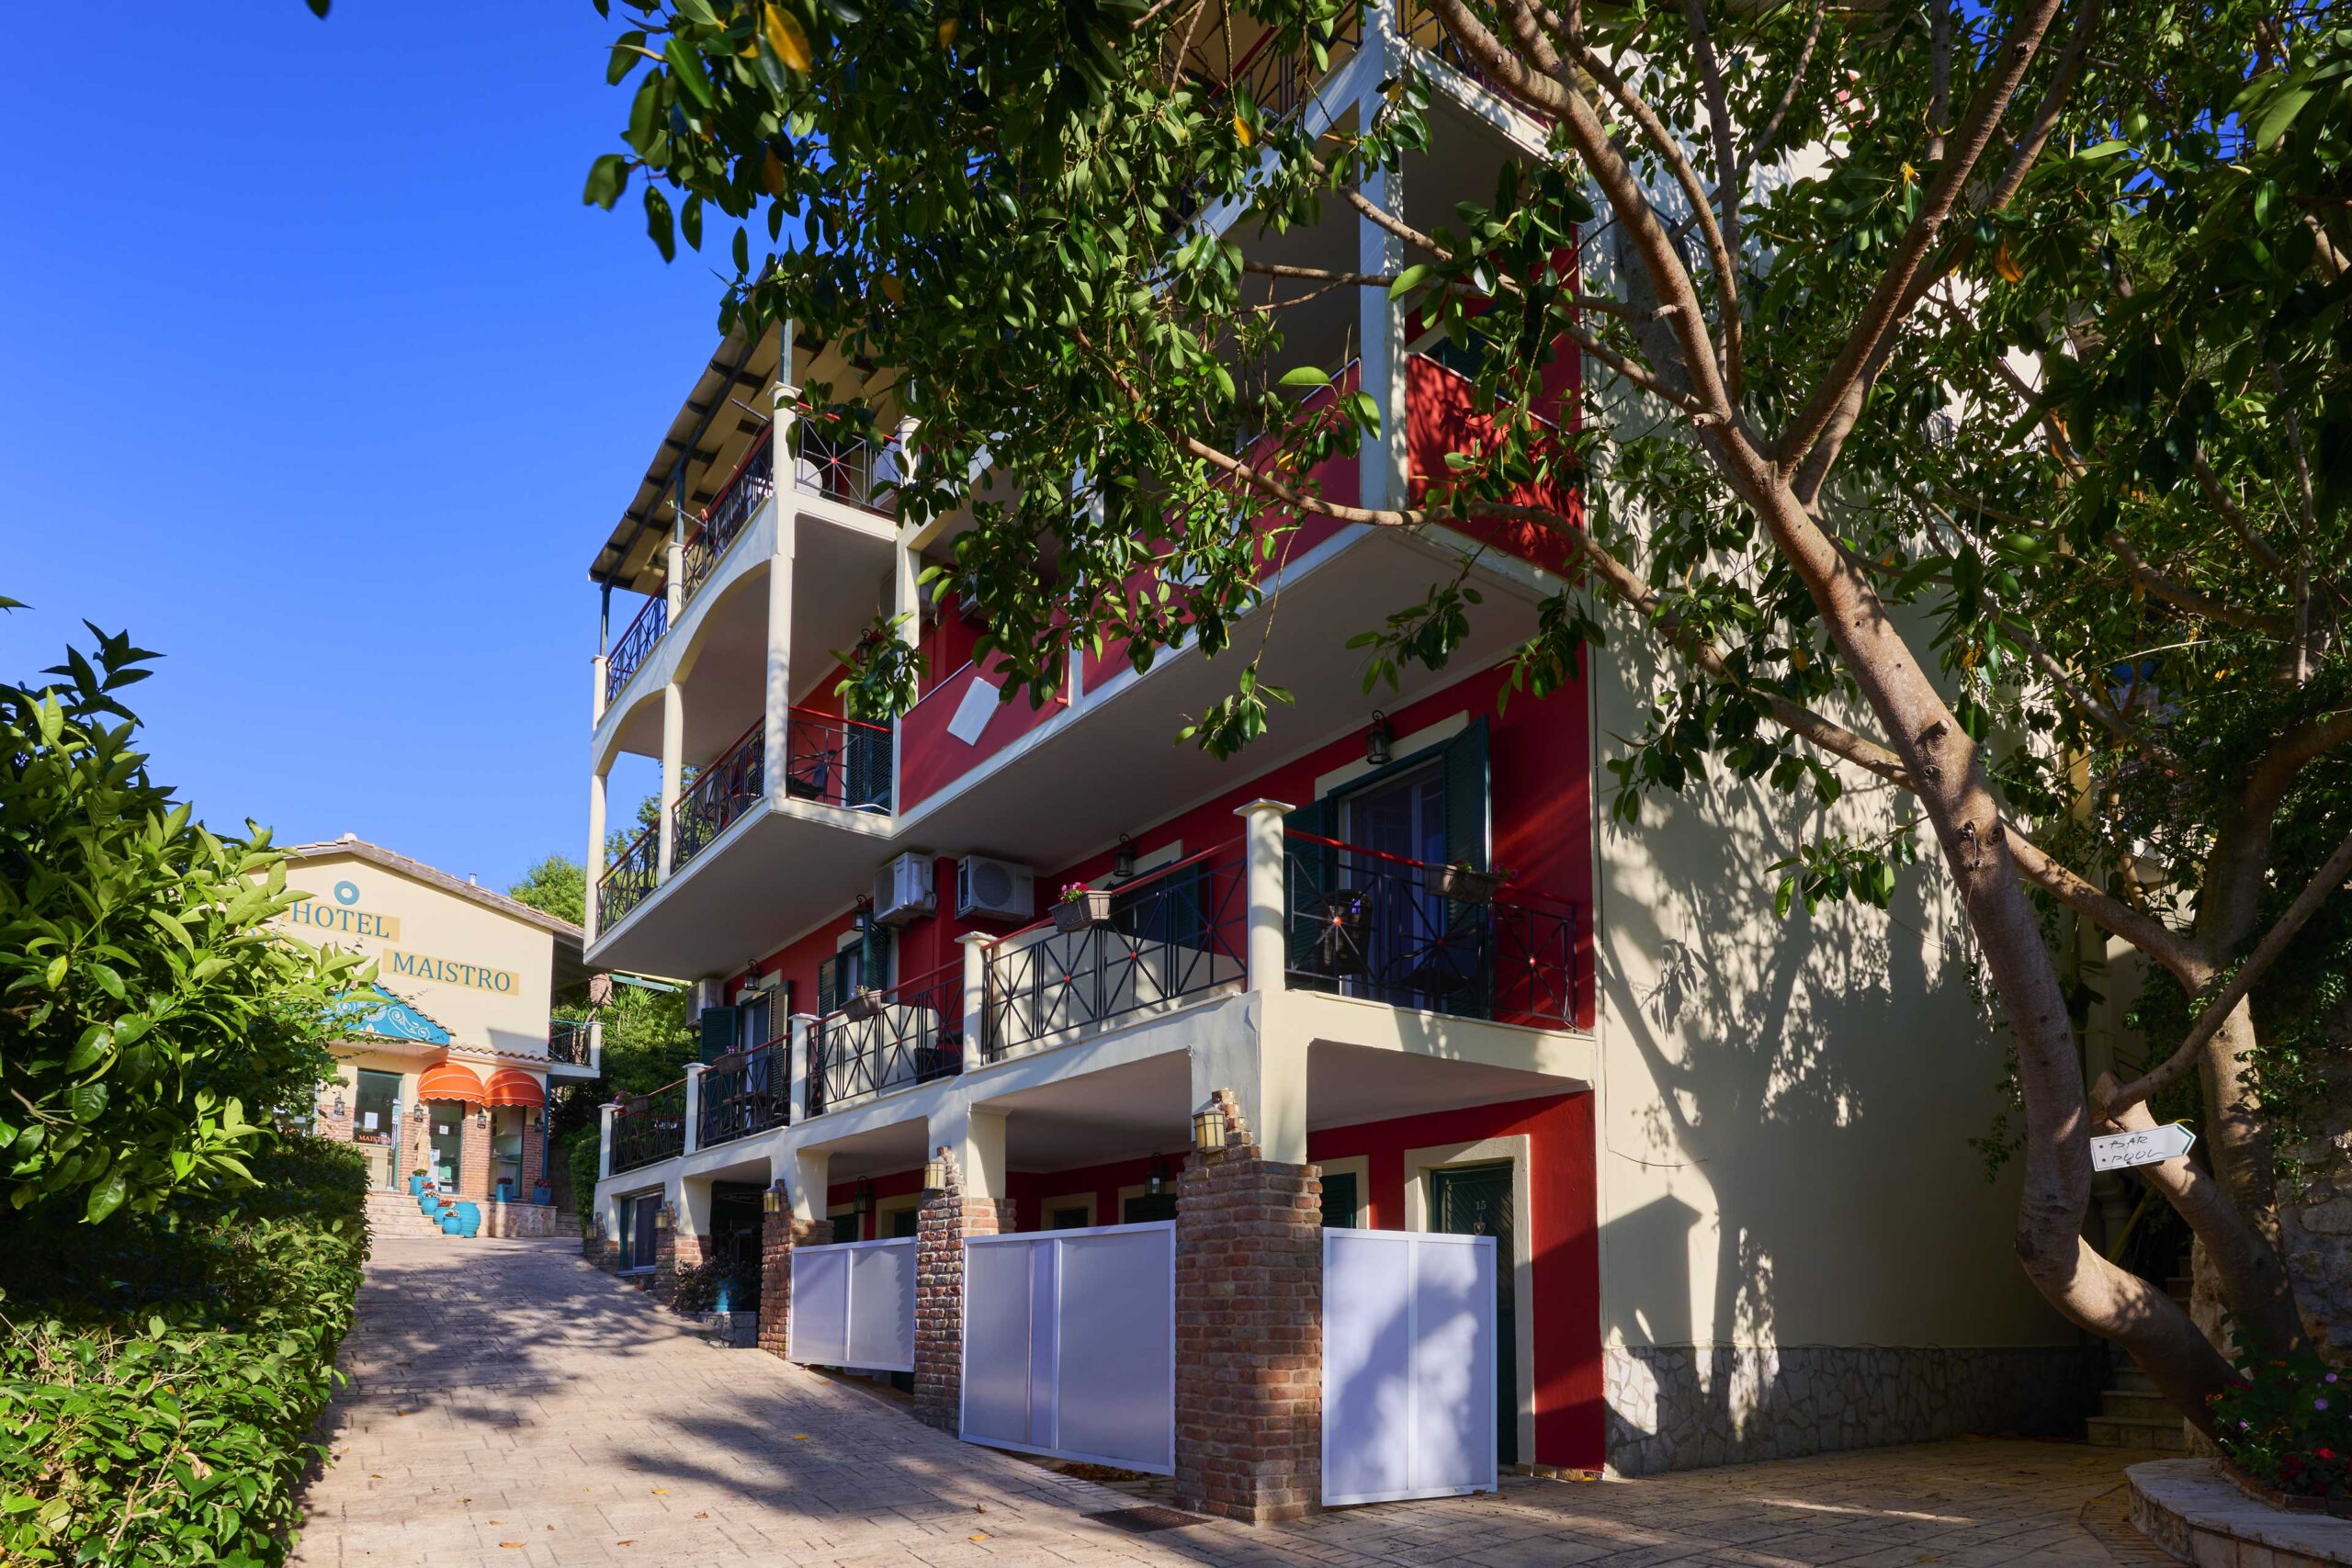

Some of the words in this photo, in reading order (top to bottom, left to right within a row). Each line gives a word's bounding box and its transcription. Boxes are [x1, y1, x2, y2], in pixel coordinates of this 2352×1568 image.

[292, 900, 390, 939] HOTEL
[393, 952, 510, 992] MAISTRO
[2109, 1136, 2148, 1149] BAR
[2111, 1149, 2165, 1163] POOL
